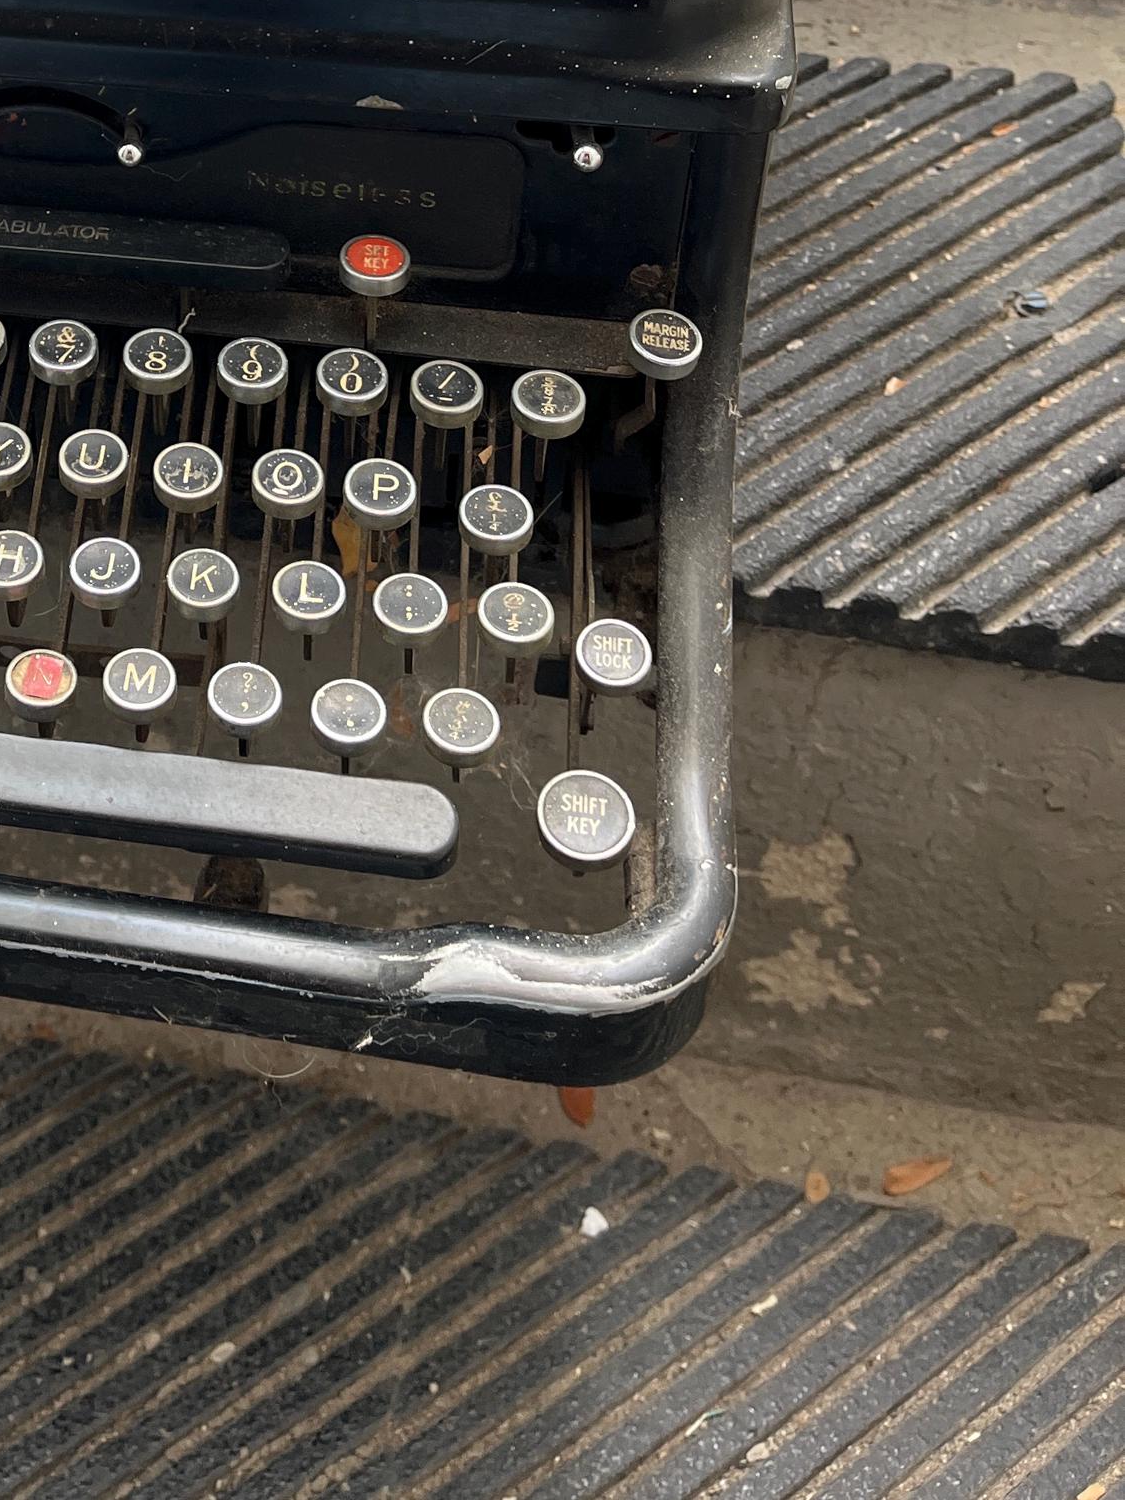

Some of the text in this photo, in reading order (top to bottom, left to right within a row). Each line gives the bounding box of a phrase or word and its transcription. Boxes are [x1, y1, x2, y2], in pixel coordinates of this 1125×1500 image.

[364, 256, 390, 270] KEY
[56, 326, 76, 344] &
[643, 321, 689, 338] MARGIN
[56, 343, 76, 363] 7
[642, 334, 691, 352] RELEASE
[144, 351, 167, 372] 8
[242, 359, 263, 381] 9
[79, 443, 107, 470] U
[273, 461, 303, 490] O
[372, 473, 401, 501] P
[89, 552, 116, 581] J
[189, 563, 218, 593] K
[298, 572, 324, 604] L
[592, 634, 633, 654] SHIFT
[595, 652, 632, 670] LOCK
[32, 663, 55, 686] N
[122, 662, 157, 694] M
[561, 792, 608, 816] SHIFT
[567, 815, 601, 836] KEY
